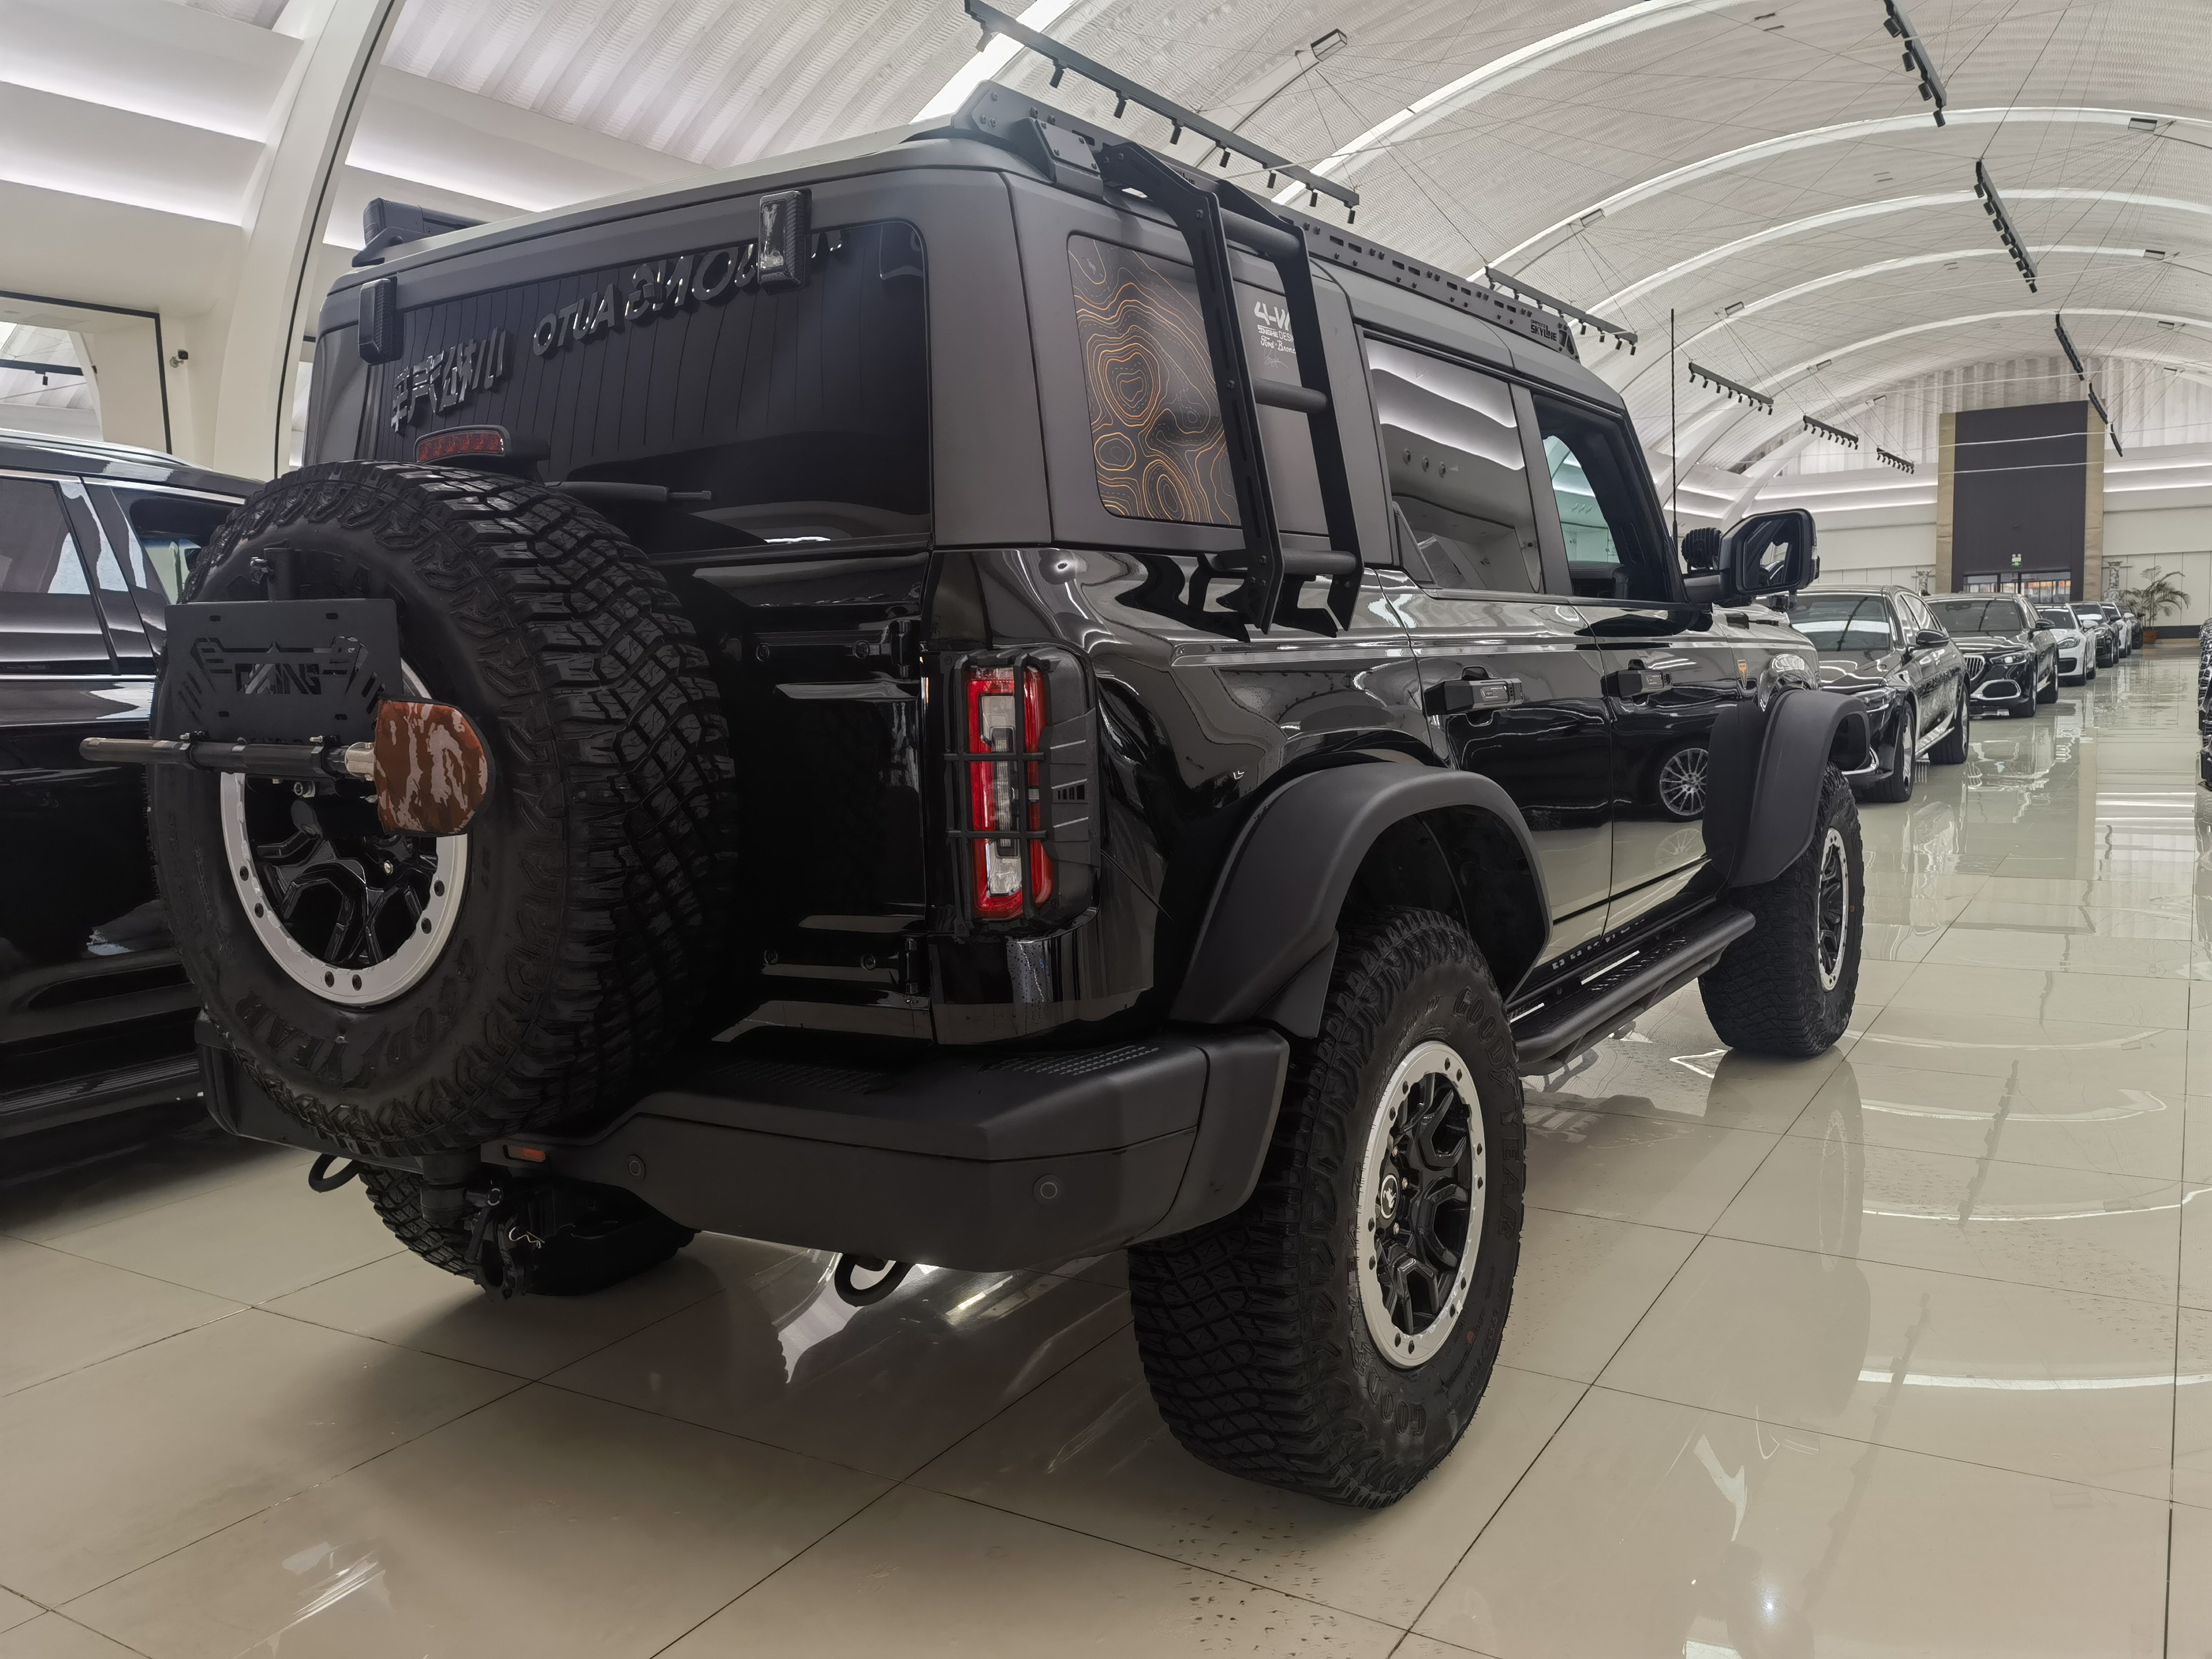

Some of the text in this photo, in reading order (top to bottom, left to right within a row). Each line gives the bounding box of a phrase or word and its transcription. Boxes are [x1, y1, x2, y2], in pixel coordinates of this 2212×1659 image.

[1278, 331, 1294, 342] DESI
[1530, 324, 1557, 341] SKYLINE
[1260, 335, 1297, 354] Ford Bronc
[1454, 986, 1521, 1240] GOODYEAR
